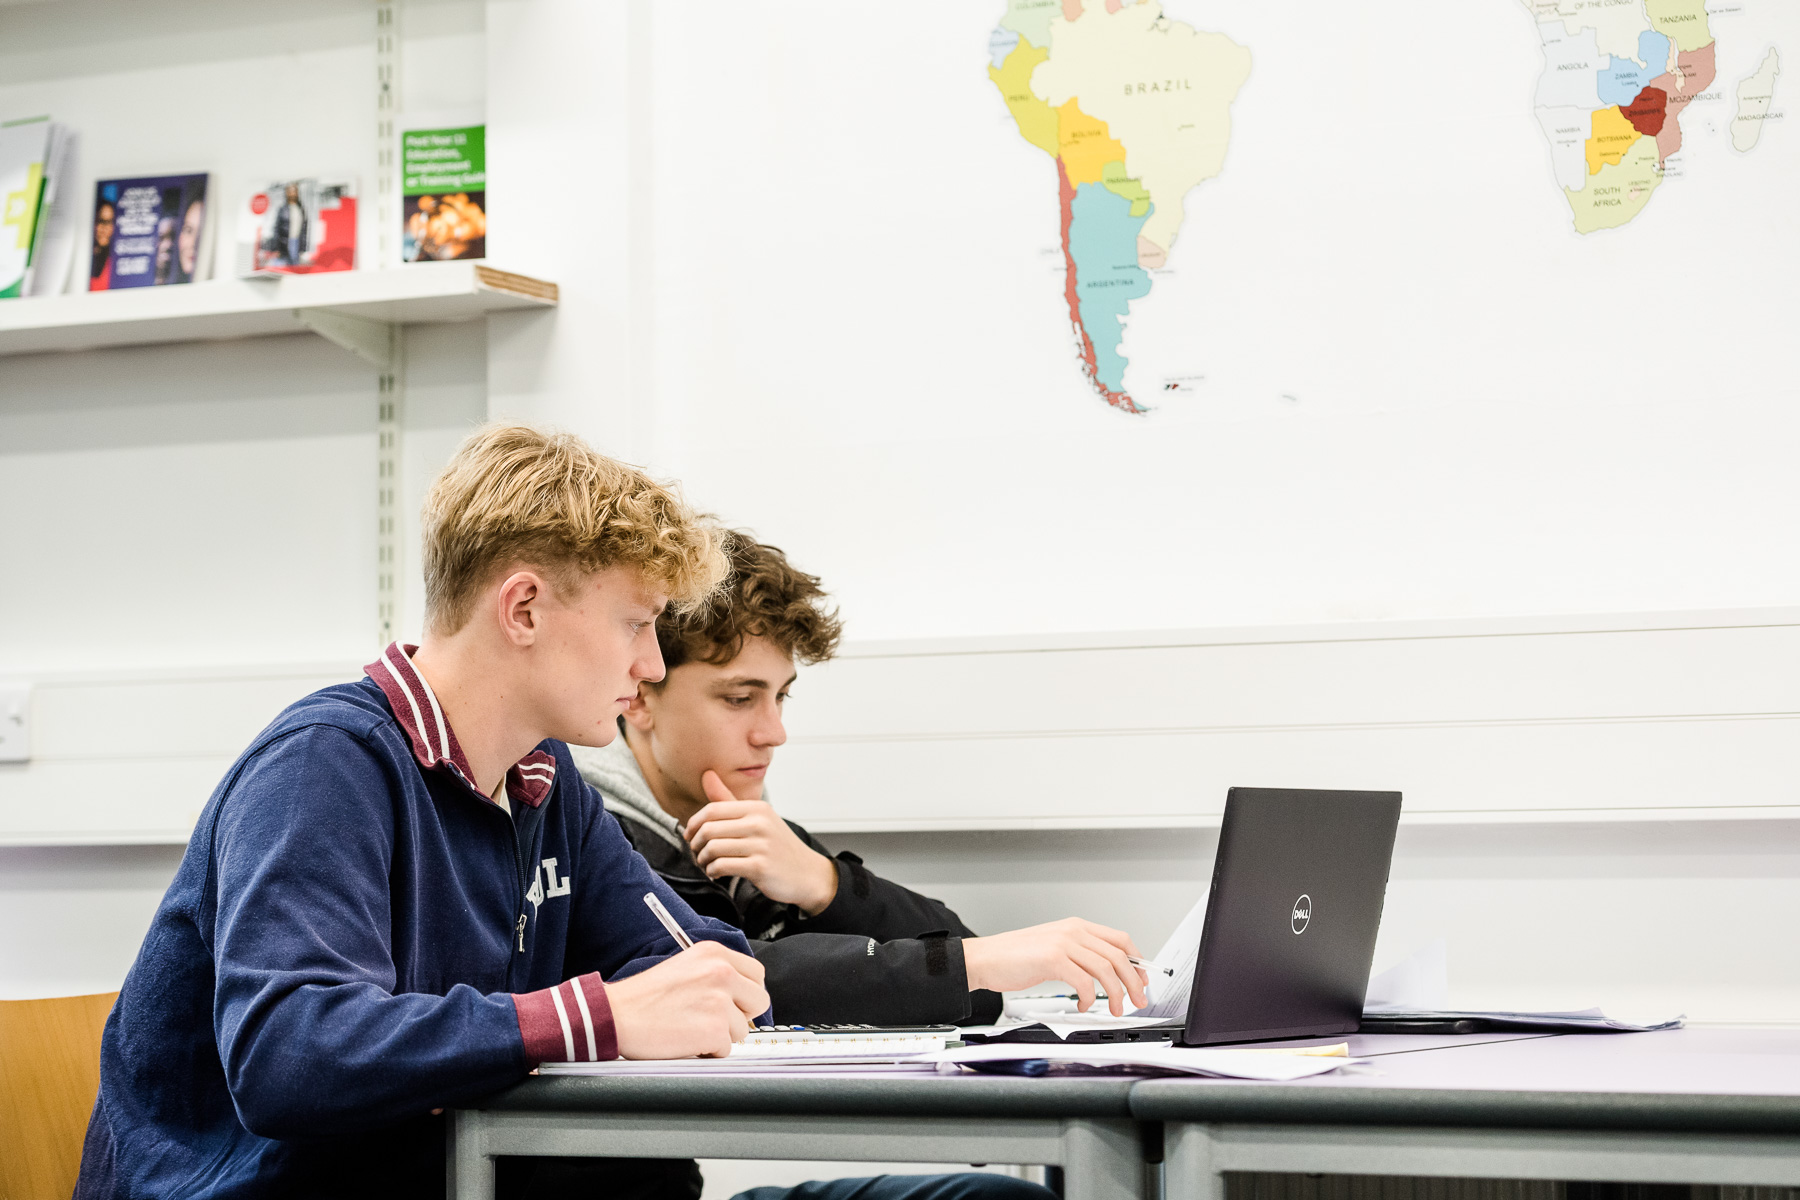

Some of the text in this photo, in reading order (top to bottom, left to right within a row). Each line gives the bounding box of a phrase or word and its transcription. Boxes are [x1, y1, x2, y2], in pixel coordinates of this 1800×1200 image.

[1588, 1, 1602, 9] THE
[1659, 14, 1697, 24] TANZANIA
[1556, 62, 1589, 71] ANGOLA
[1615, 72, 1638, 80] ZAMBIA
[1124, 79, 1192, 96] BRAZIL
[1669, 92, 1722, 104] MOZAMBIQUE
[1737, 112, 1784, 121] MADAGASCAR
[1071, 130, 1102, 138] BOLIVIA
[1555, 126, 1581, 134] NAMIBIA
[1597, 134, 1632, 143] BOTSWANA
[1593, 187, 1621, 195] SOUTH
[1593, 199, 1622, 208] AFRICA
[1086, 279, 1134, 289] ARGENTINA
